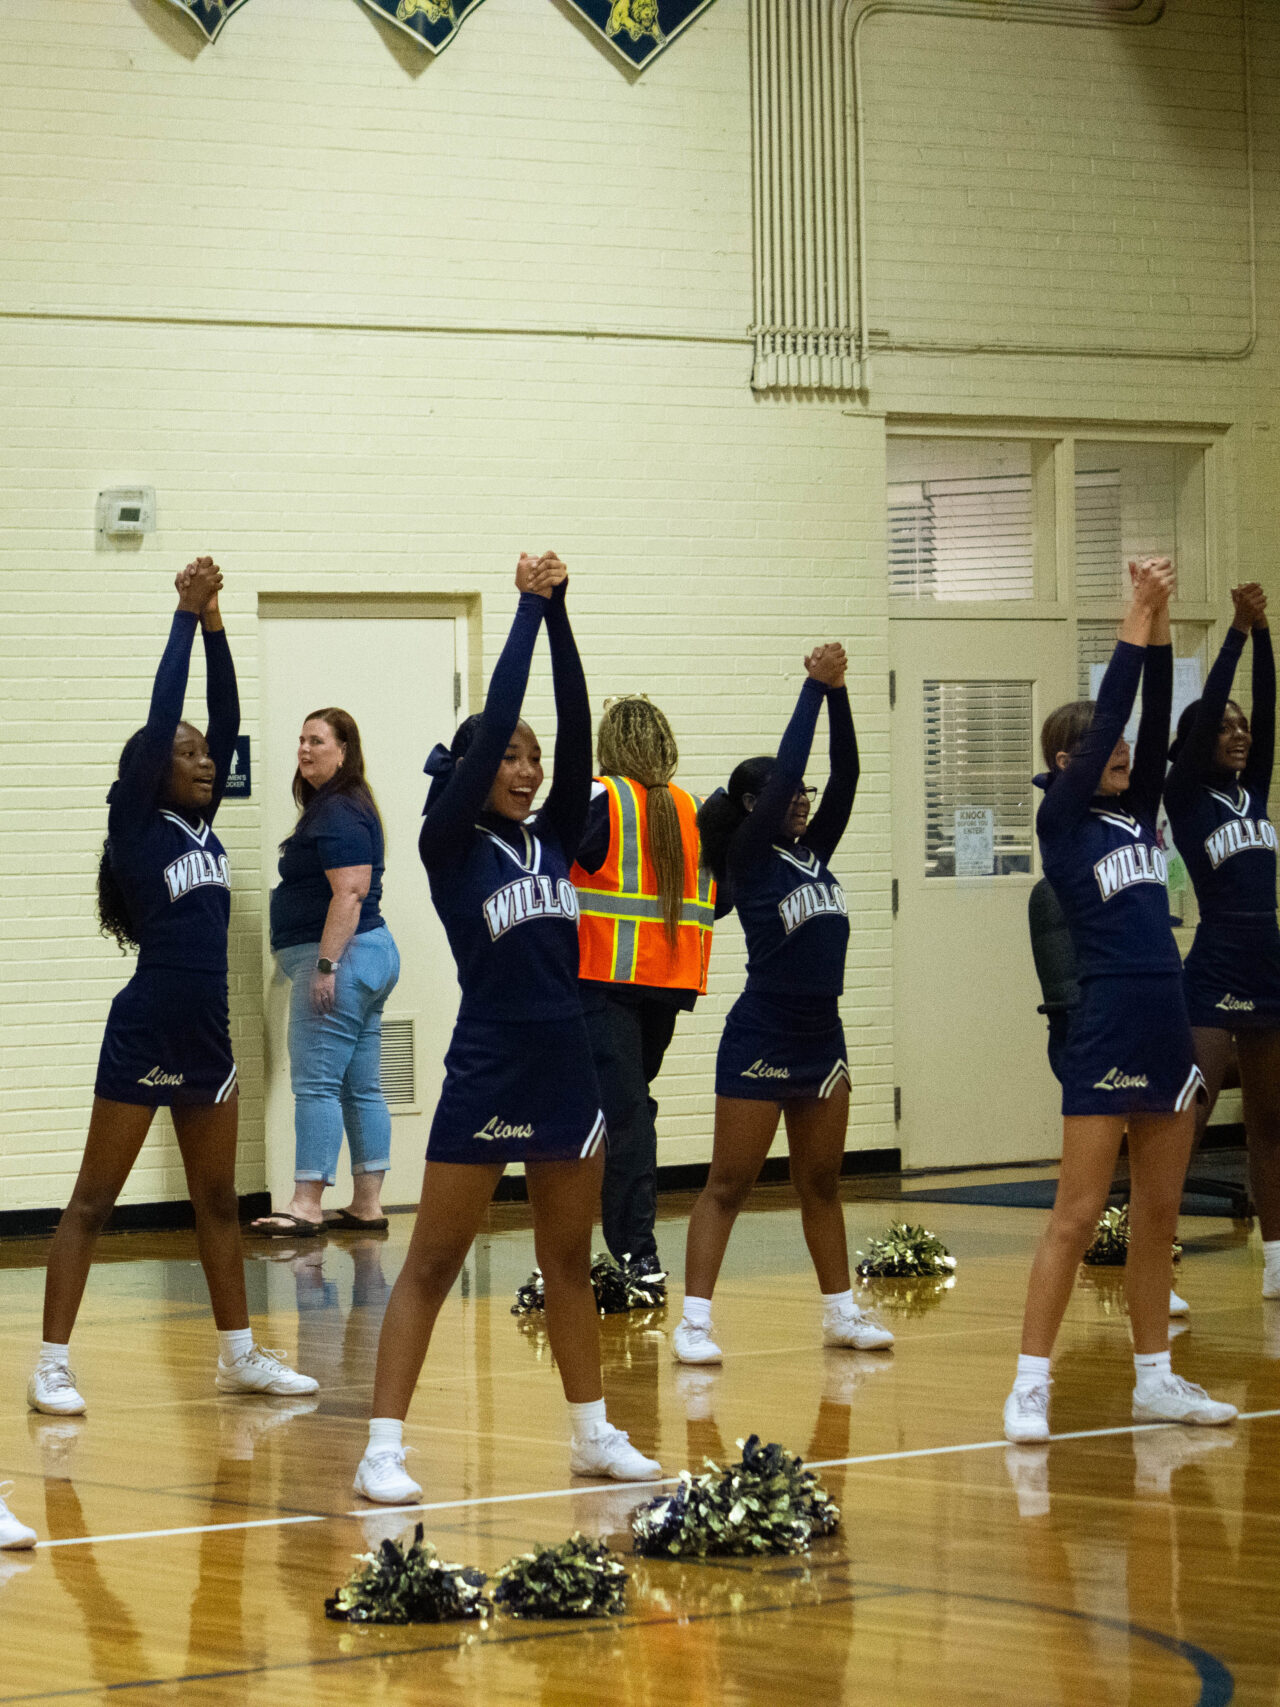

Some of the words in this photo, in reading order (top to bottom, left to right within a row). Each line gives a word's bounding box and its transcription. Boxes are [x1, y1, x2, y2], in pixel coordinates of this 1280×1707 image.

[960, 810, 986, 820] KNOCK
[1204, 818, 1278, 870] WILLO
[1093, 843, 1169, 902] WILLO
[483, 875, 580, 942] WILLO
[1215, 993, 1256, 1011] Lions
[137, 1065, 185, 1087] Lions
[740, 1059, 790, 1079] Lions
[1093, 1066, 1149, 1090] Lions
[473, 1115, 535, 1140] Lions
